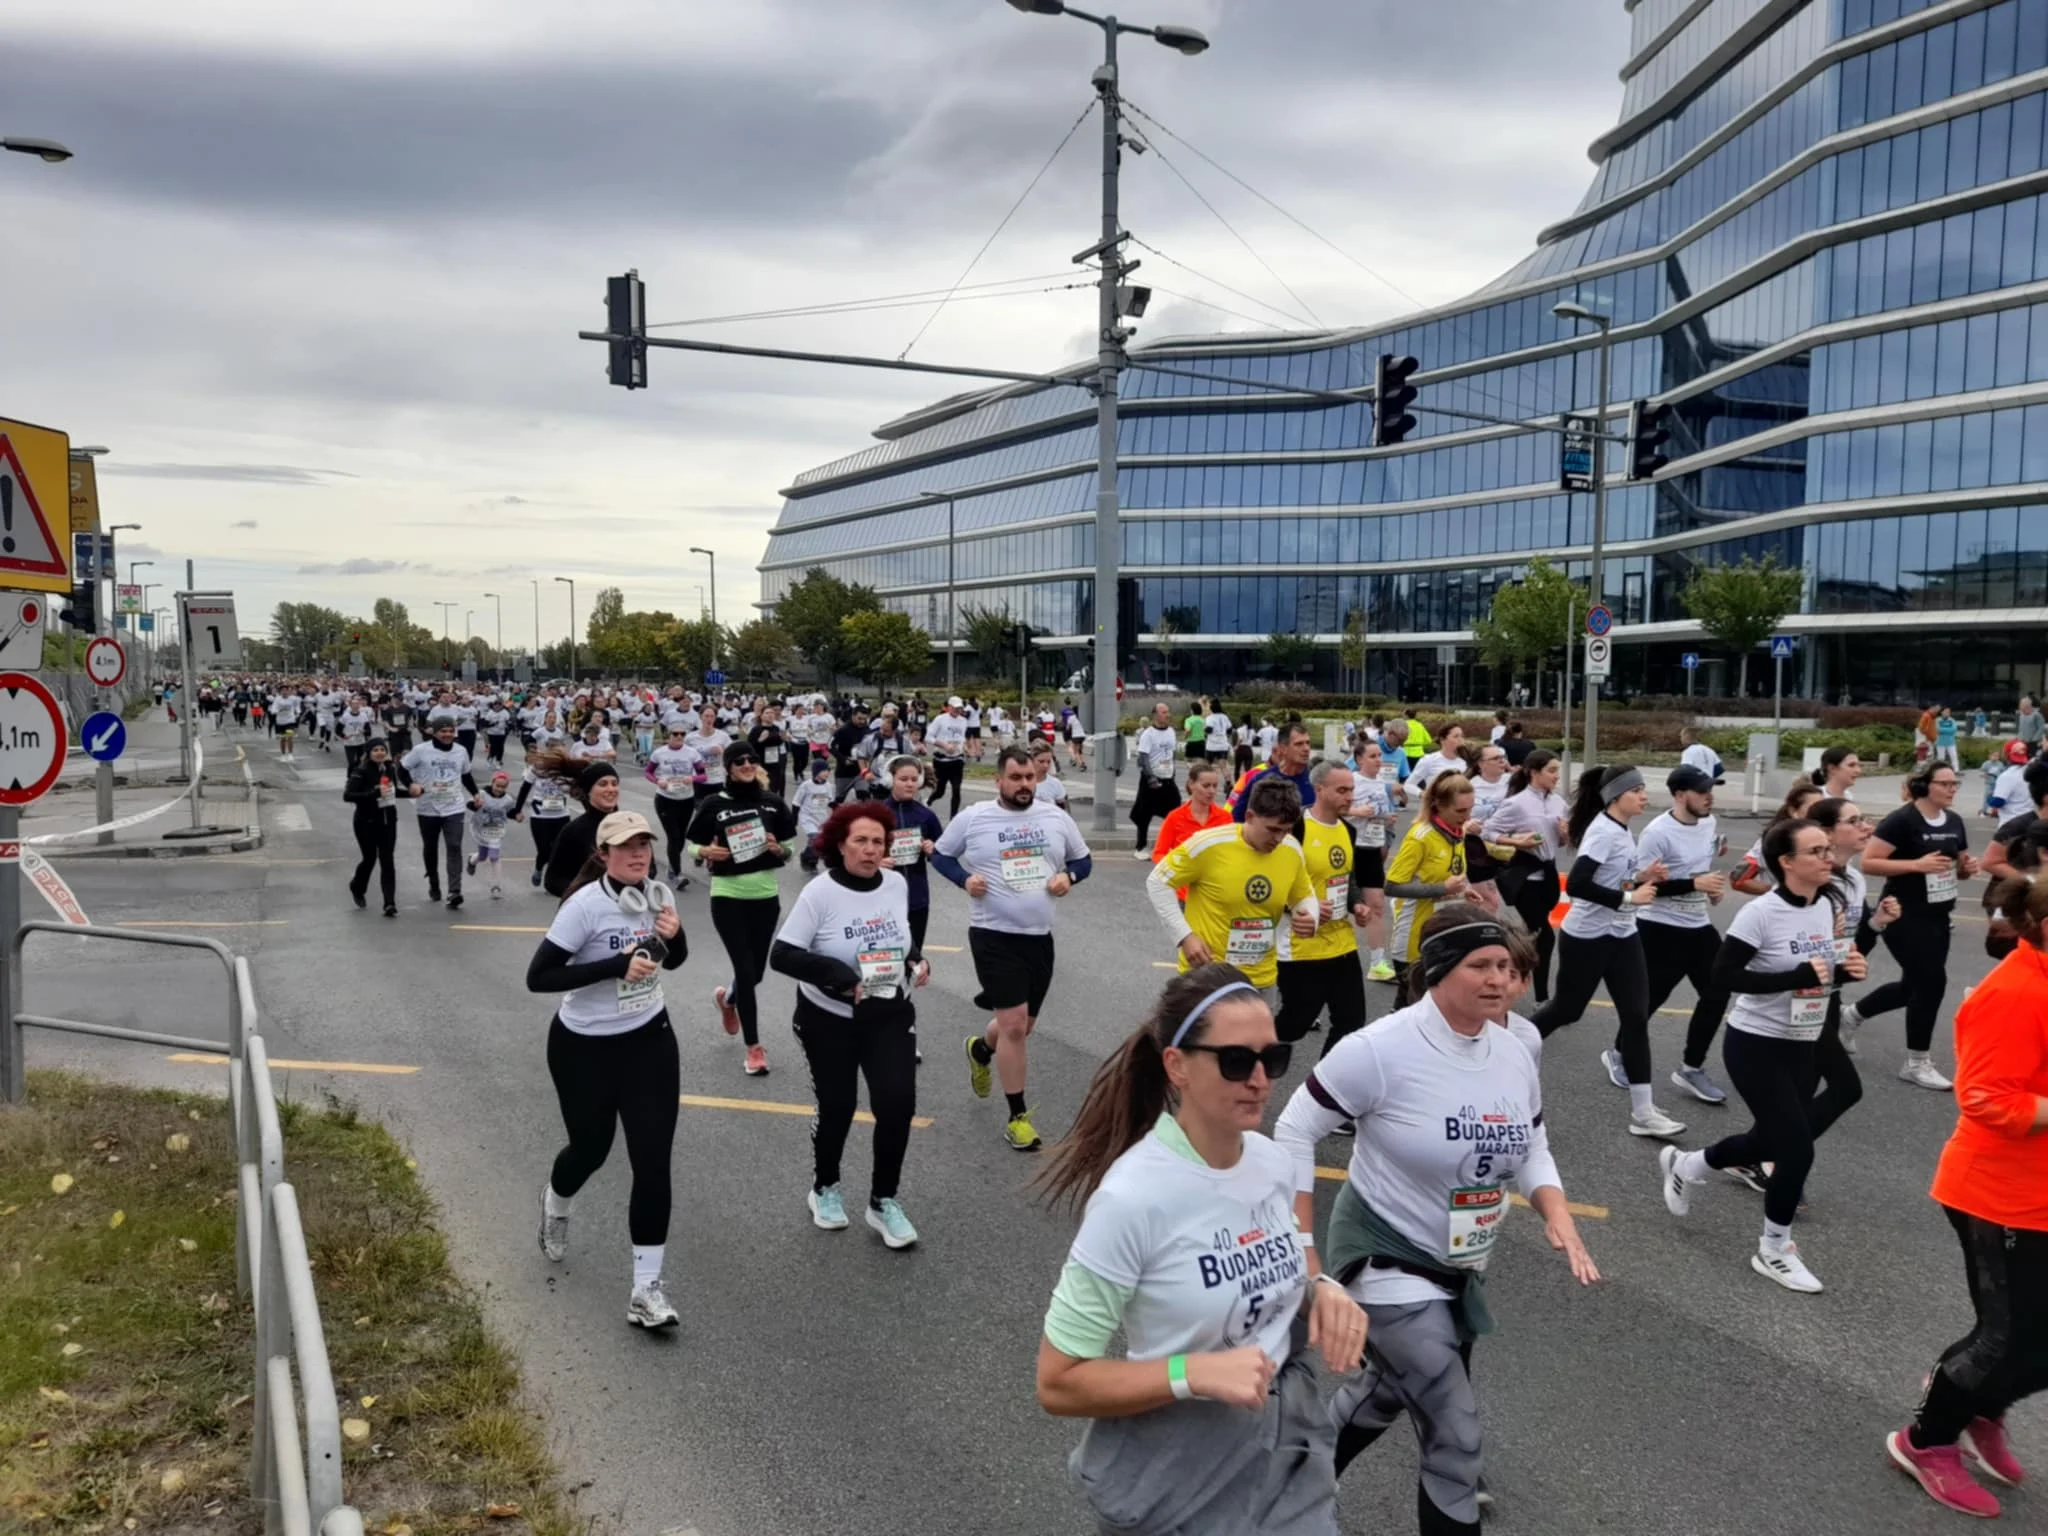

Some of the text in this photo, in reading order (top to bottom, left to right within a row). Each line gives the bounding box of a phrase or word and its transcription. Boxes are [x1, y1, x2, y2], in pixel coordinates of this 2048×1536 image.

[206, 625, 221, 654] 1
[844, 920, 899, 940] BUDAPEST
[1445, 1117, 1530, 1142] BUDAPEST
[1475, 1156, 1494, 1179] 5
[1465, 1190, 1503, 1204] SPA
[1198, 1232, 1297, 1289] BUDAPEST
[1240, 1257, 1299, 1297] MARATON
[1244, 1294, 1265, 1330] 5
